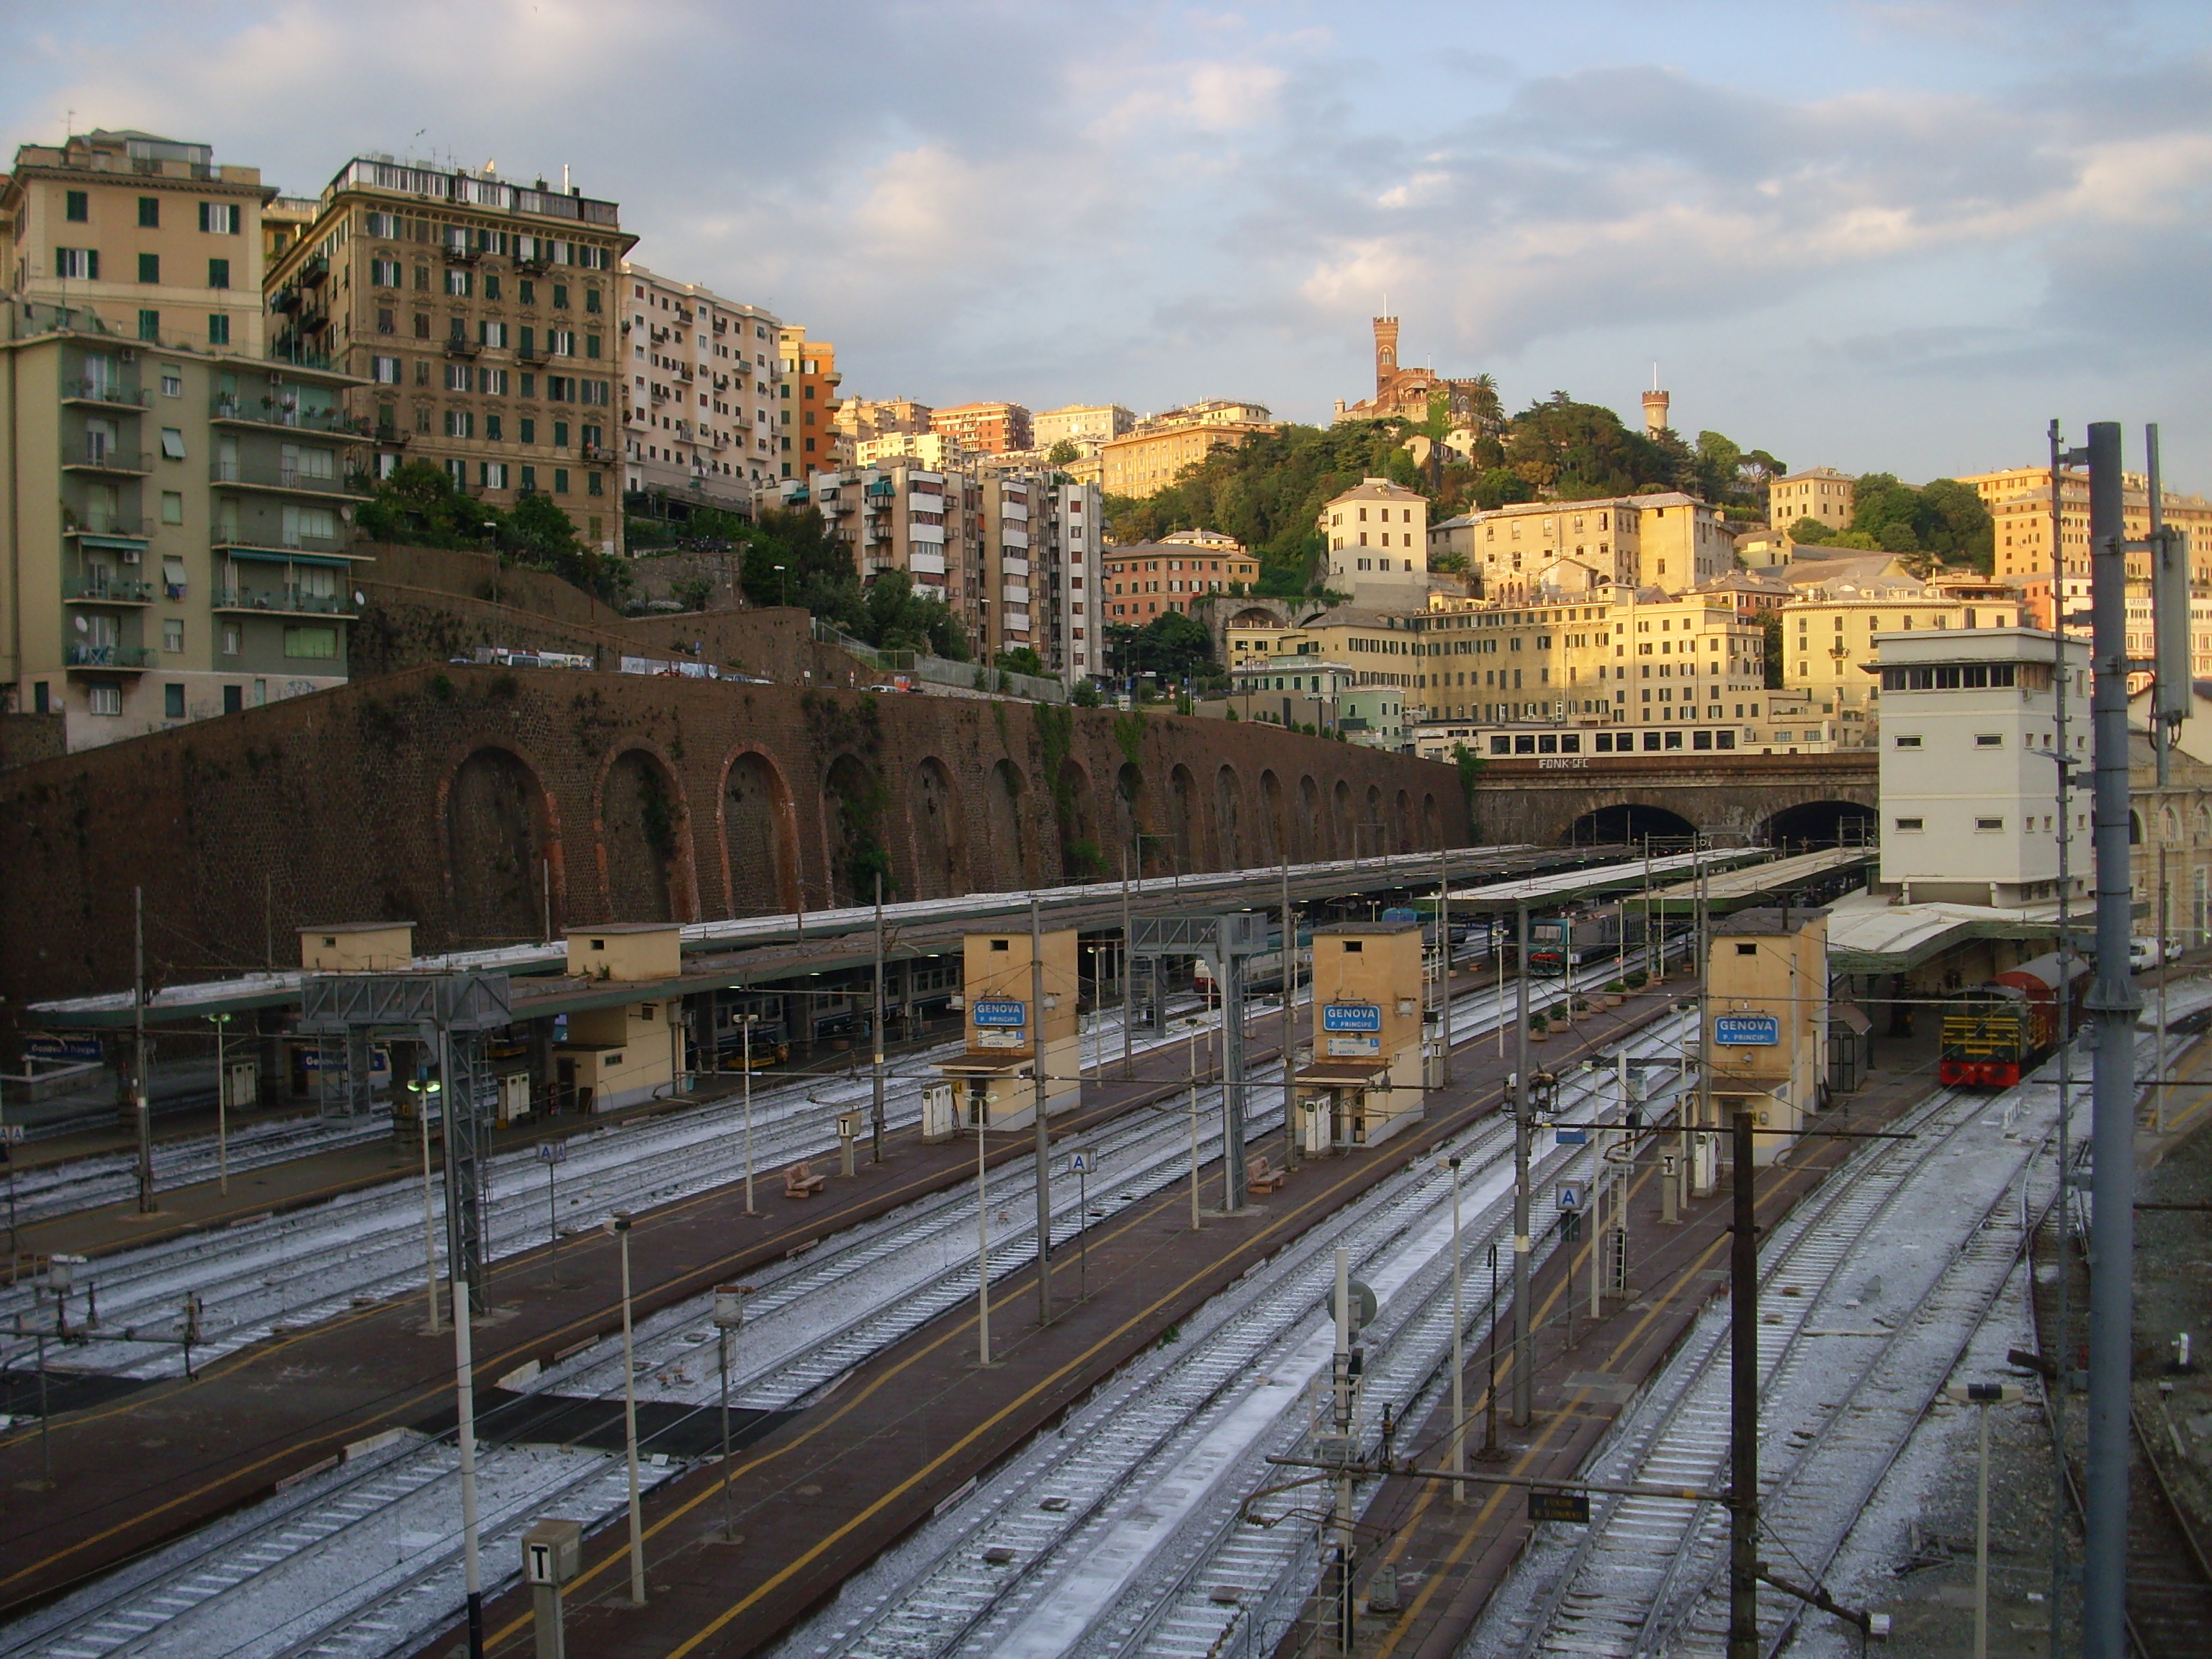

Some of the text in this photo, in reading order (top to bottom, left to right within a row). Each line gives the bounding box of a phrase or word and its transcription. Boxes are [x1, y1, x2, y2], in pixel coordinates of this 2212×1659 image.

[977, 1004, 1020, 1013] GENOVA
[1328, 1009, 1375, 1018] GENOVA
[1719, 1020, 1773, 1031] GENOVA
[1434, 1043, 1441, 1055] T
[14, 1128, 22, 1138] A
[840, 1119, 849, 1134] T
[0, 1128, 7, 1139] A
[541, 1146, 551, 1159] A
[558, 1145, 565, 1158] A
[1074, 1155, 1085, 1169] A
[1665, 1156, 1674, 1173] T
[1562, 1190, 1575, 1205] A
[531, 1545, 548, 1579] T
